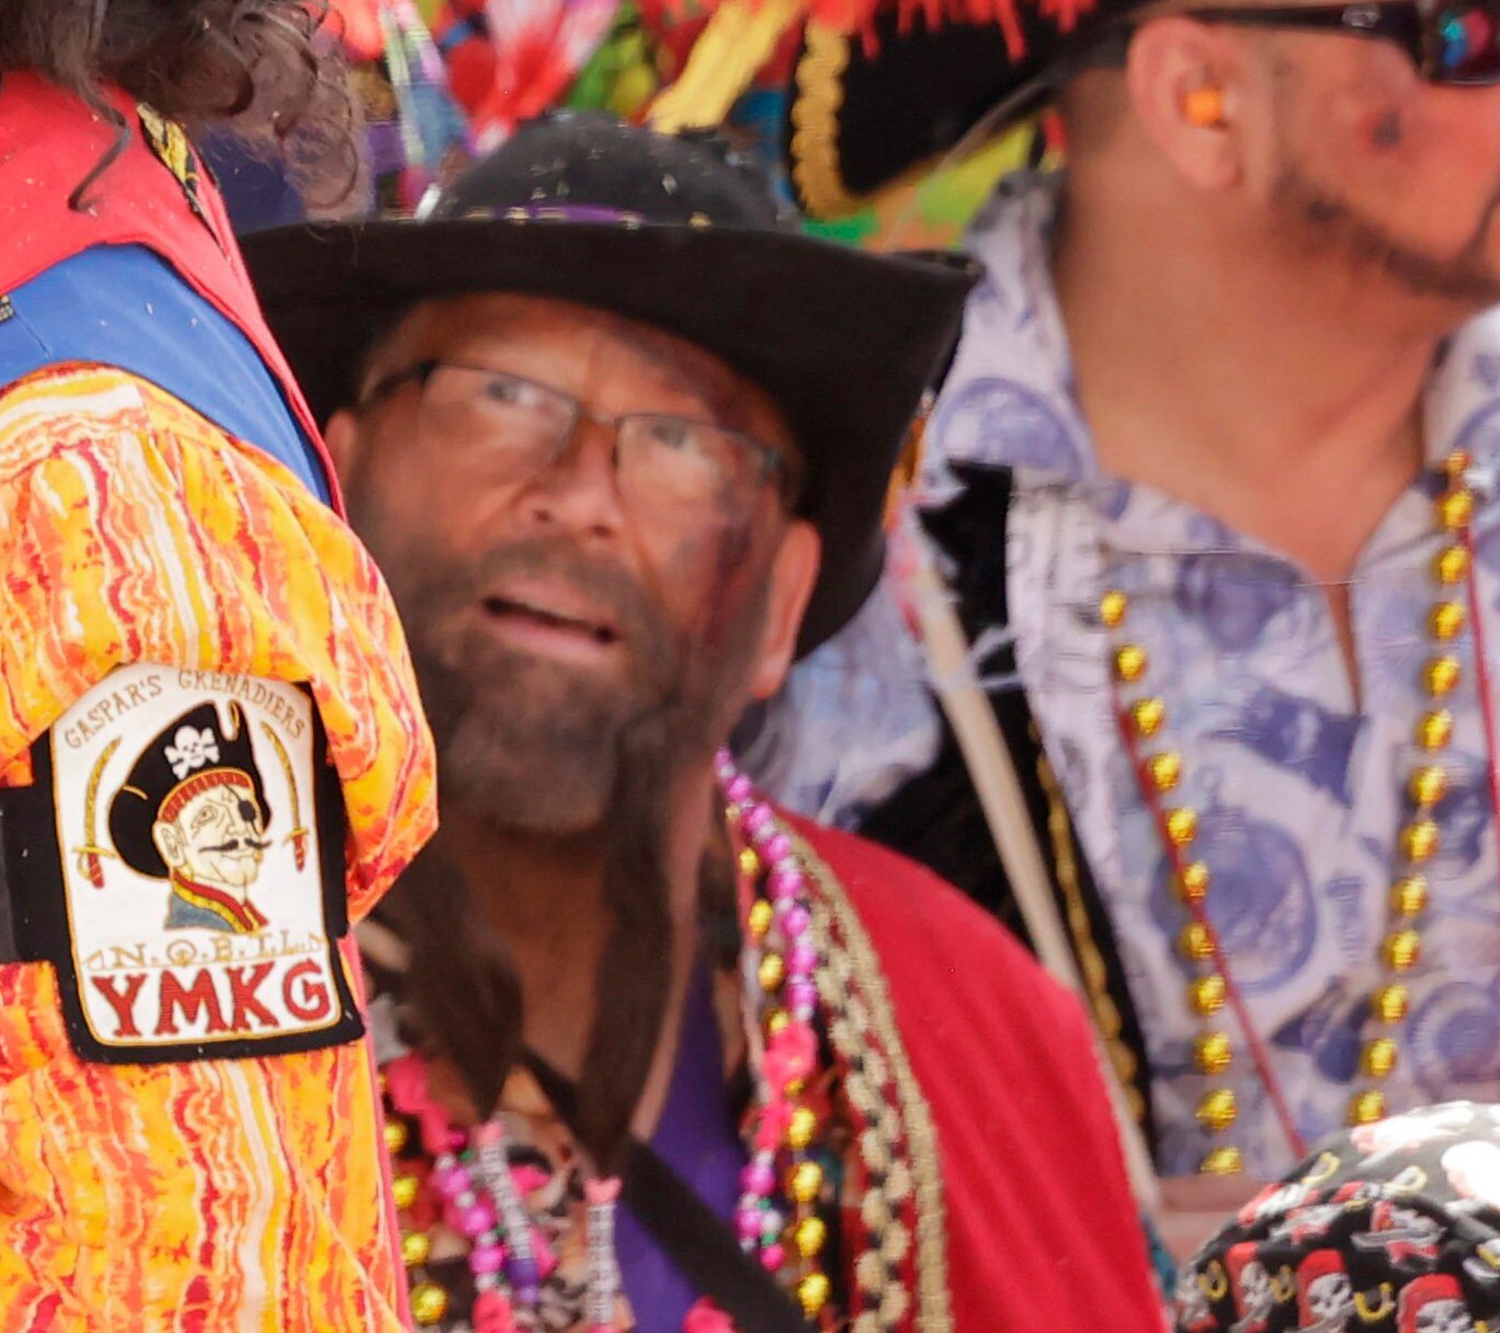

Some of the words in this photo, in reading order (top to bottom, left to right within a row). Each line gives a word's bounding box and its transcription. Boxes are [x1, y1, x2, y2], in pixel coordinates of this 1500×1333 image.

[64, 673, 164, 750] GASPAR'S
[177, 666, 307, 740] GRENADIERS
[91, 957, 331, 1037] YMKG
